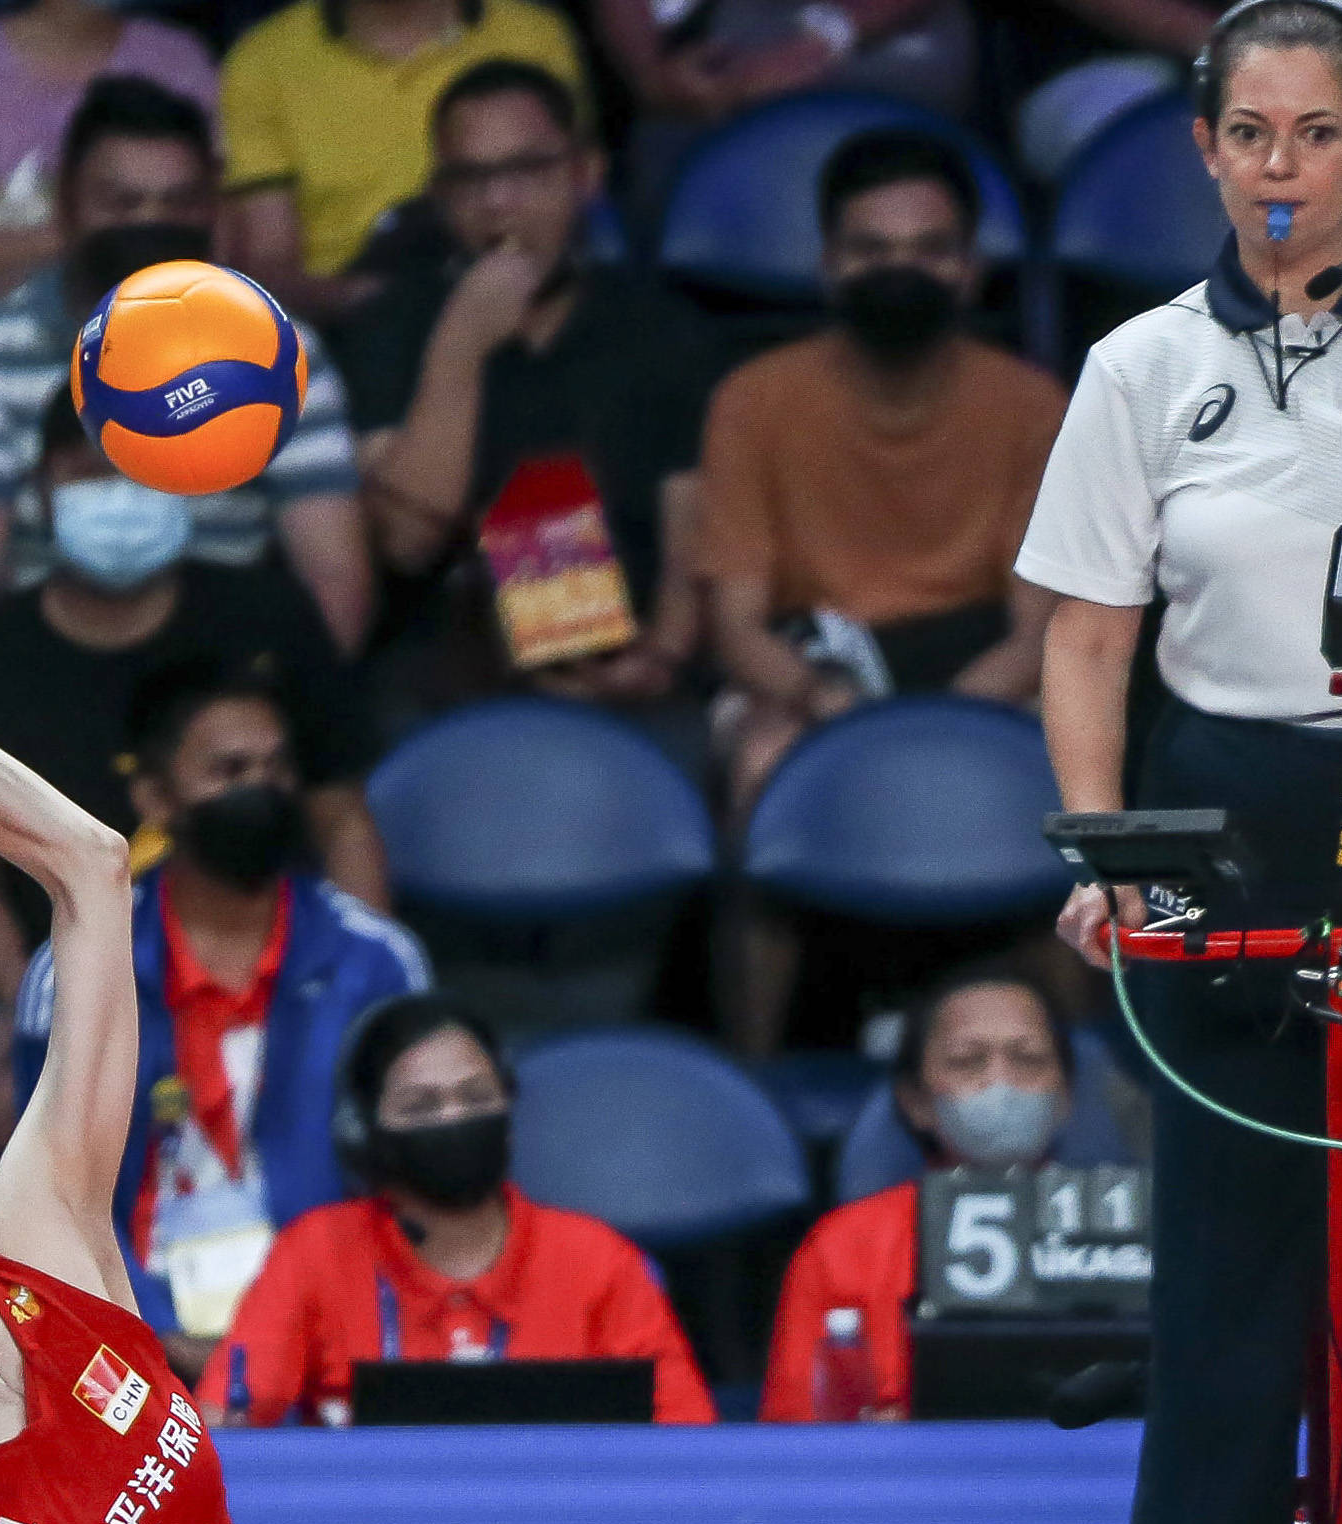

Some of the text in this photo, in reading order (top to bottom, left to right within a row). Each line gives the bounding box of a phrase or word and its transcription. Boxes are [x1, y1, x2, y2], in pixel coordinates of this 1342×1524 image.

[164, 378, 211, 408] FIVB
[943, 1193, 1021, 1300] 5
[113, 1378, 144, 1421] CHN
